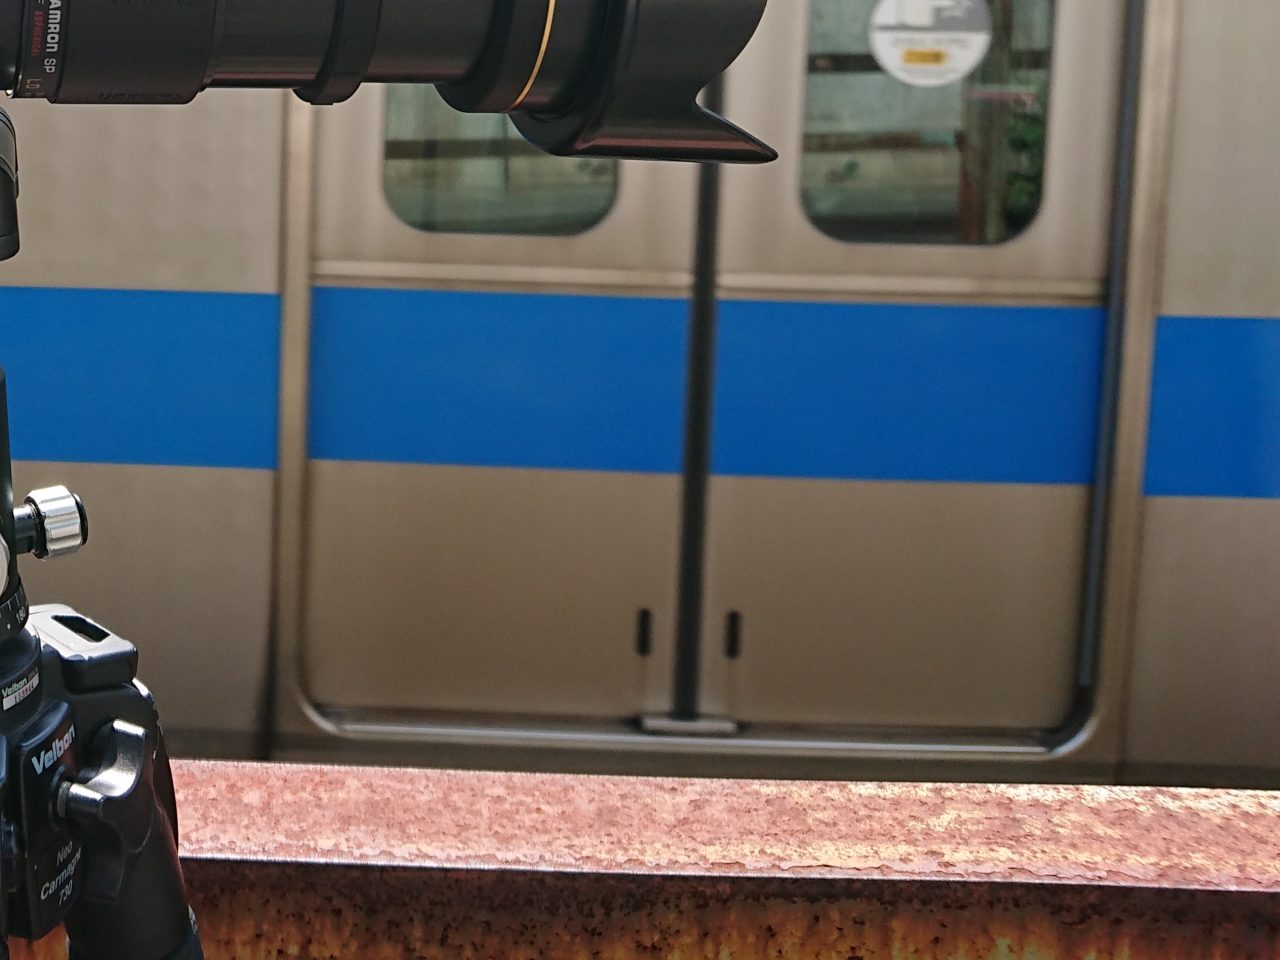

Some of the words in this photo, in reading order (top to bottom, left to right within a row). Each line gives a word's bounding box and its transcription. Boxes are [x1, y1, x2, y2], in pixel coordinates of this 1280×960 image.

[44, 58, 56, 73] SP
[2, 678, 28, 698] Velbon
[31, 724, 76, 775] Velbon
[56, 841, 72, 867] Neo
[58, 880, 73, 906] 730
